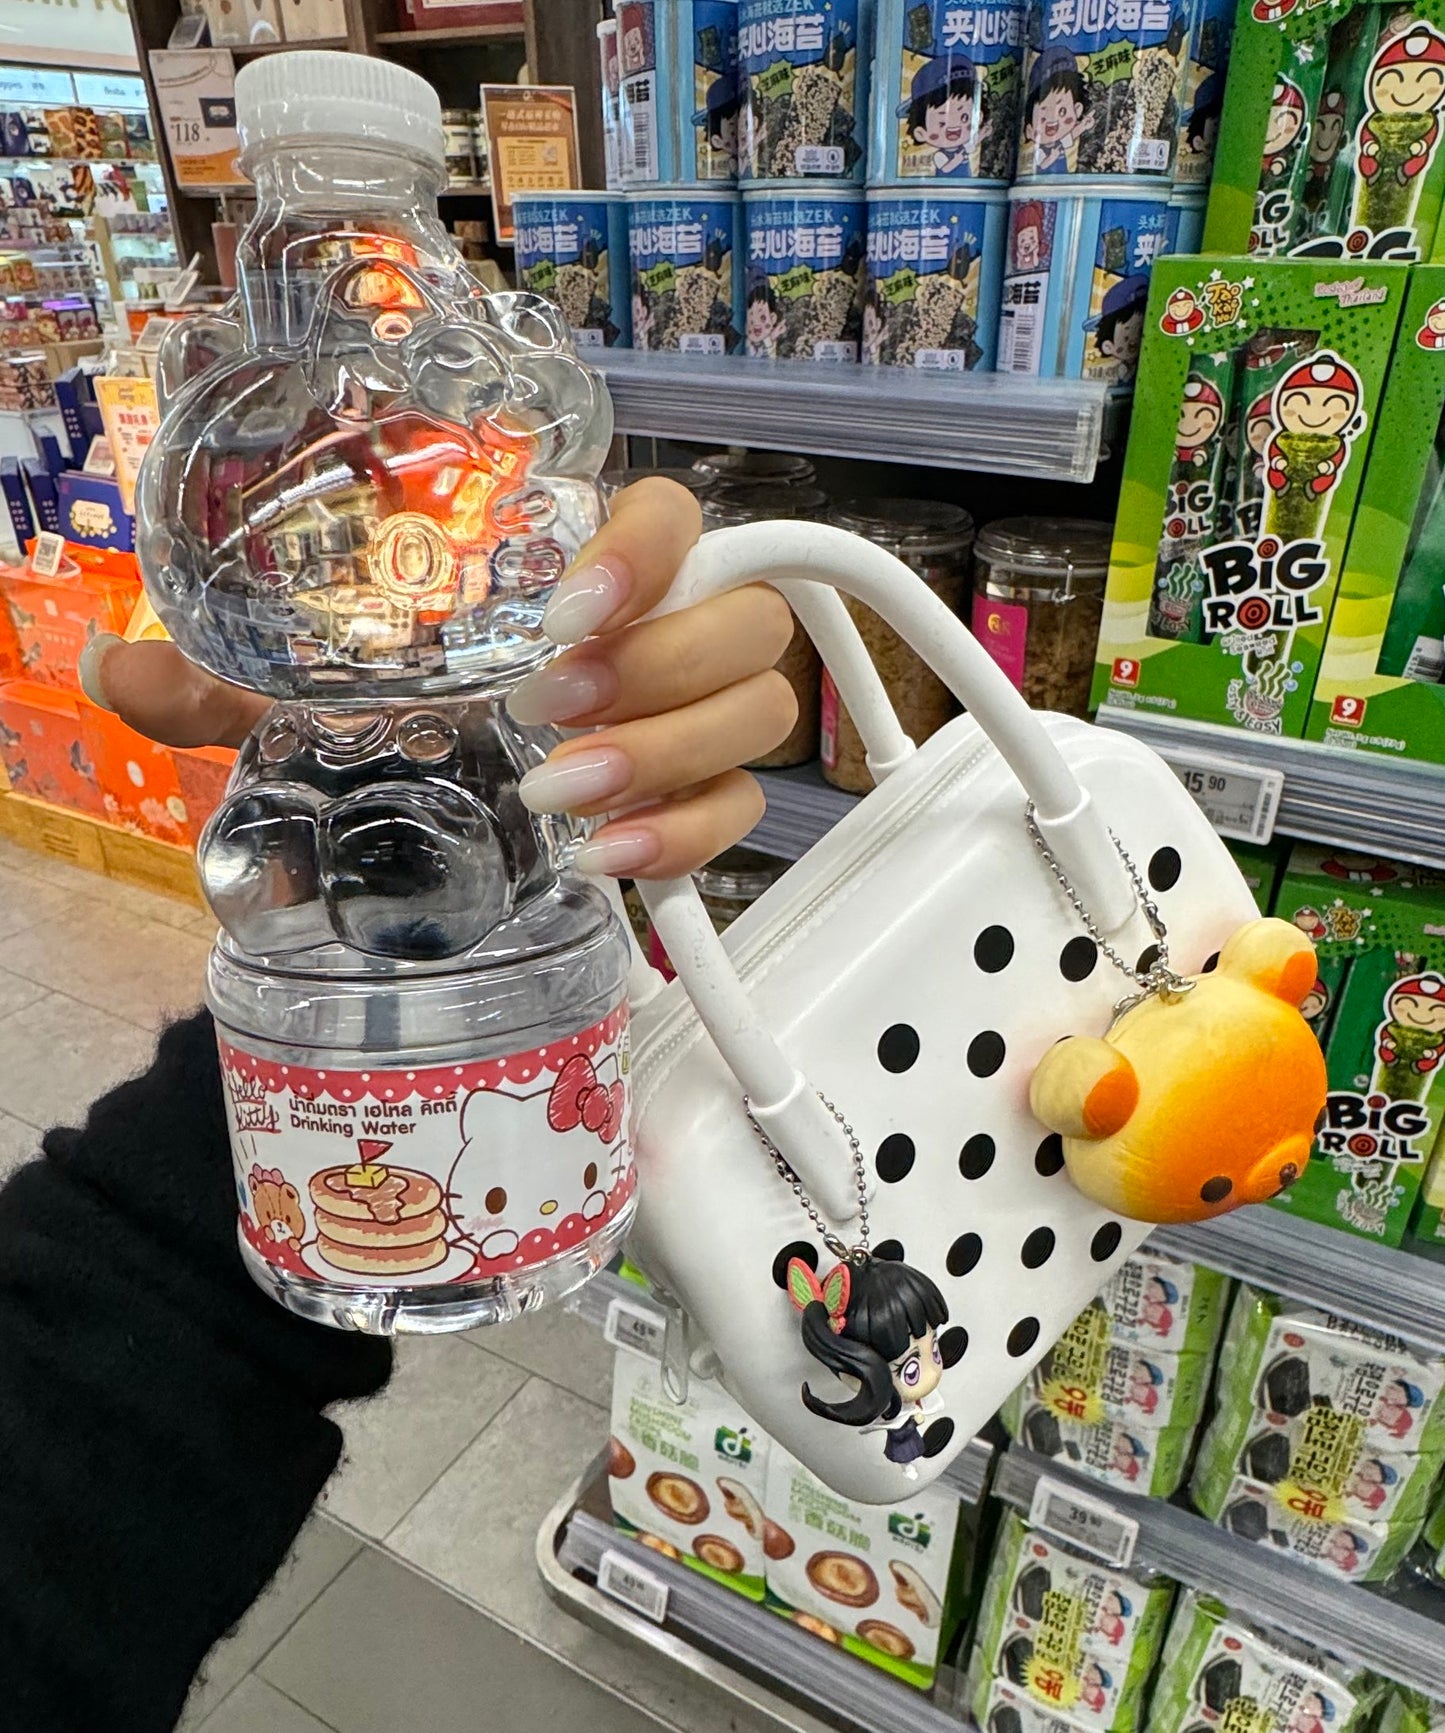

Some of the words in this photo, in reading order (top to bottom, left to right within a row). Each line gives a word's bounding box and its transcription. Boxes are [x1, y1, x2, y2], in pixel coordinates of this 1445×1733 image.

[1048, 0, 1171, 40] 夹心海苔
[1092, 48, 1132, 76] 芝麻味
[750, 225, 843, 260] 夹心海苔
[867, 225, 950, 262] 夹心海苔
[1165, 516, 1211, 539] OLL
[1203, 538, 1326, 597] BiG
[1206, 595, 1319, 631] ROLL
[1120, 660, 1134, 678] 9
[1342, 698, 1357, 716] 9
[1183, 770, 1227, 796] 15.90
[228, 1073, 267, 1103] Hello
[234, 1103, 280, 1132] Kitty
[290, 1114, 354, 1138] Drinking
[361, 1120, 417, 1136] Water
[1327, 1095, 1428, 1136] BiG
[1322, 1132, 1420, 1160] ROLL
